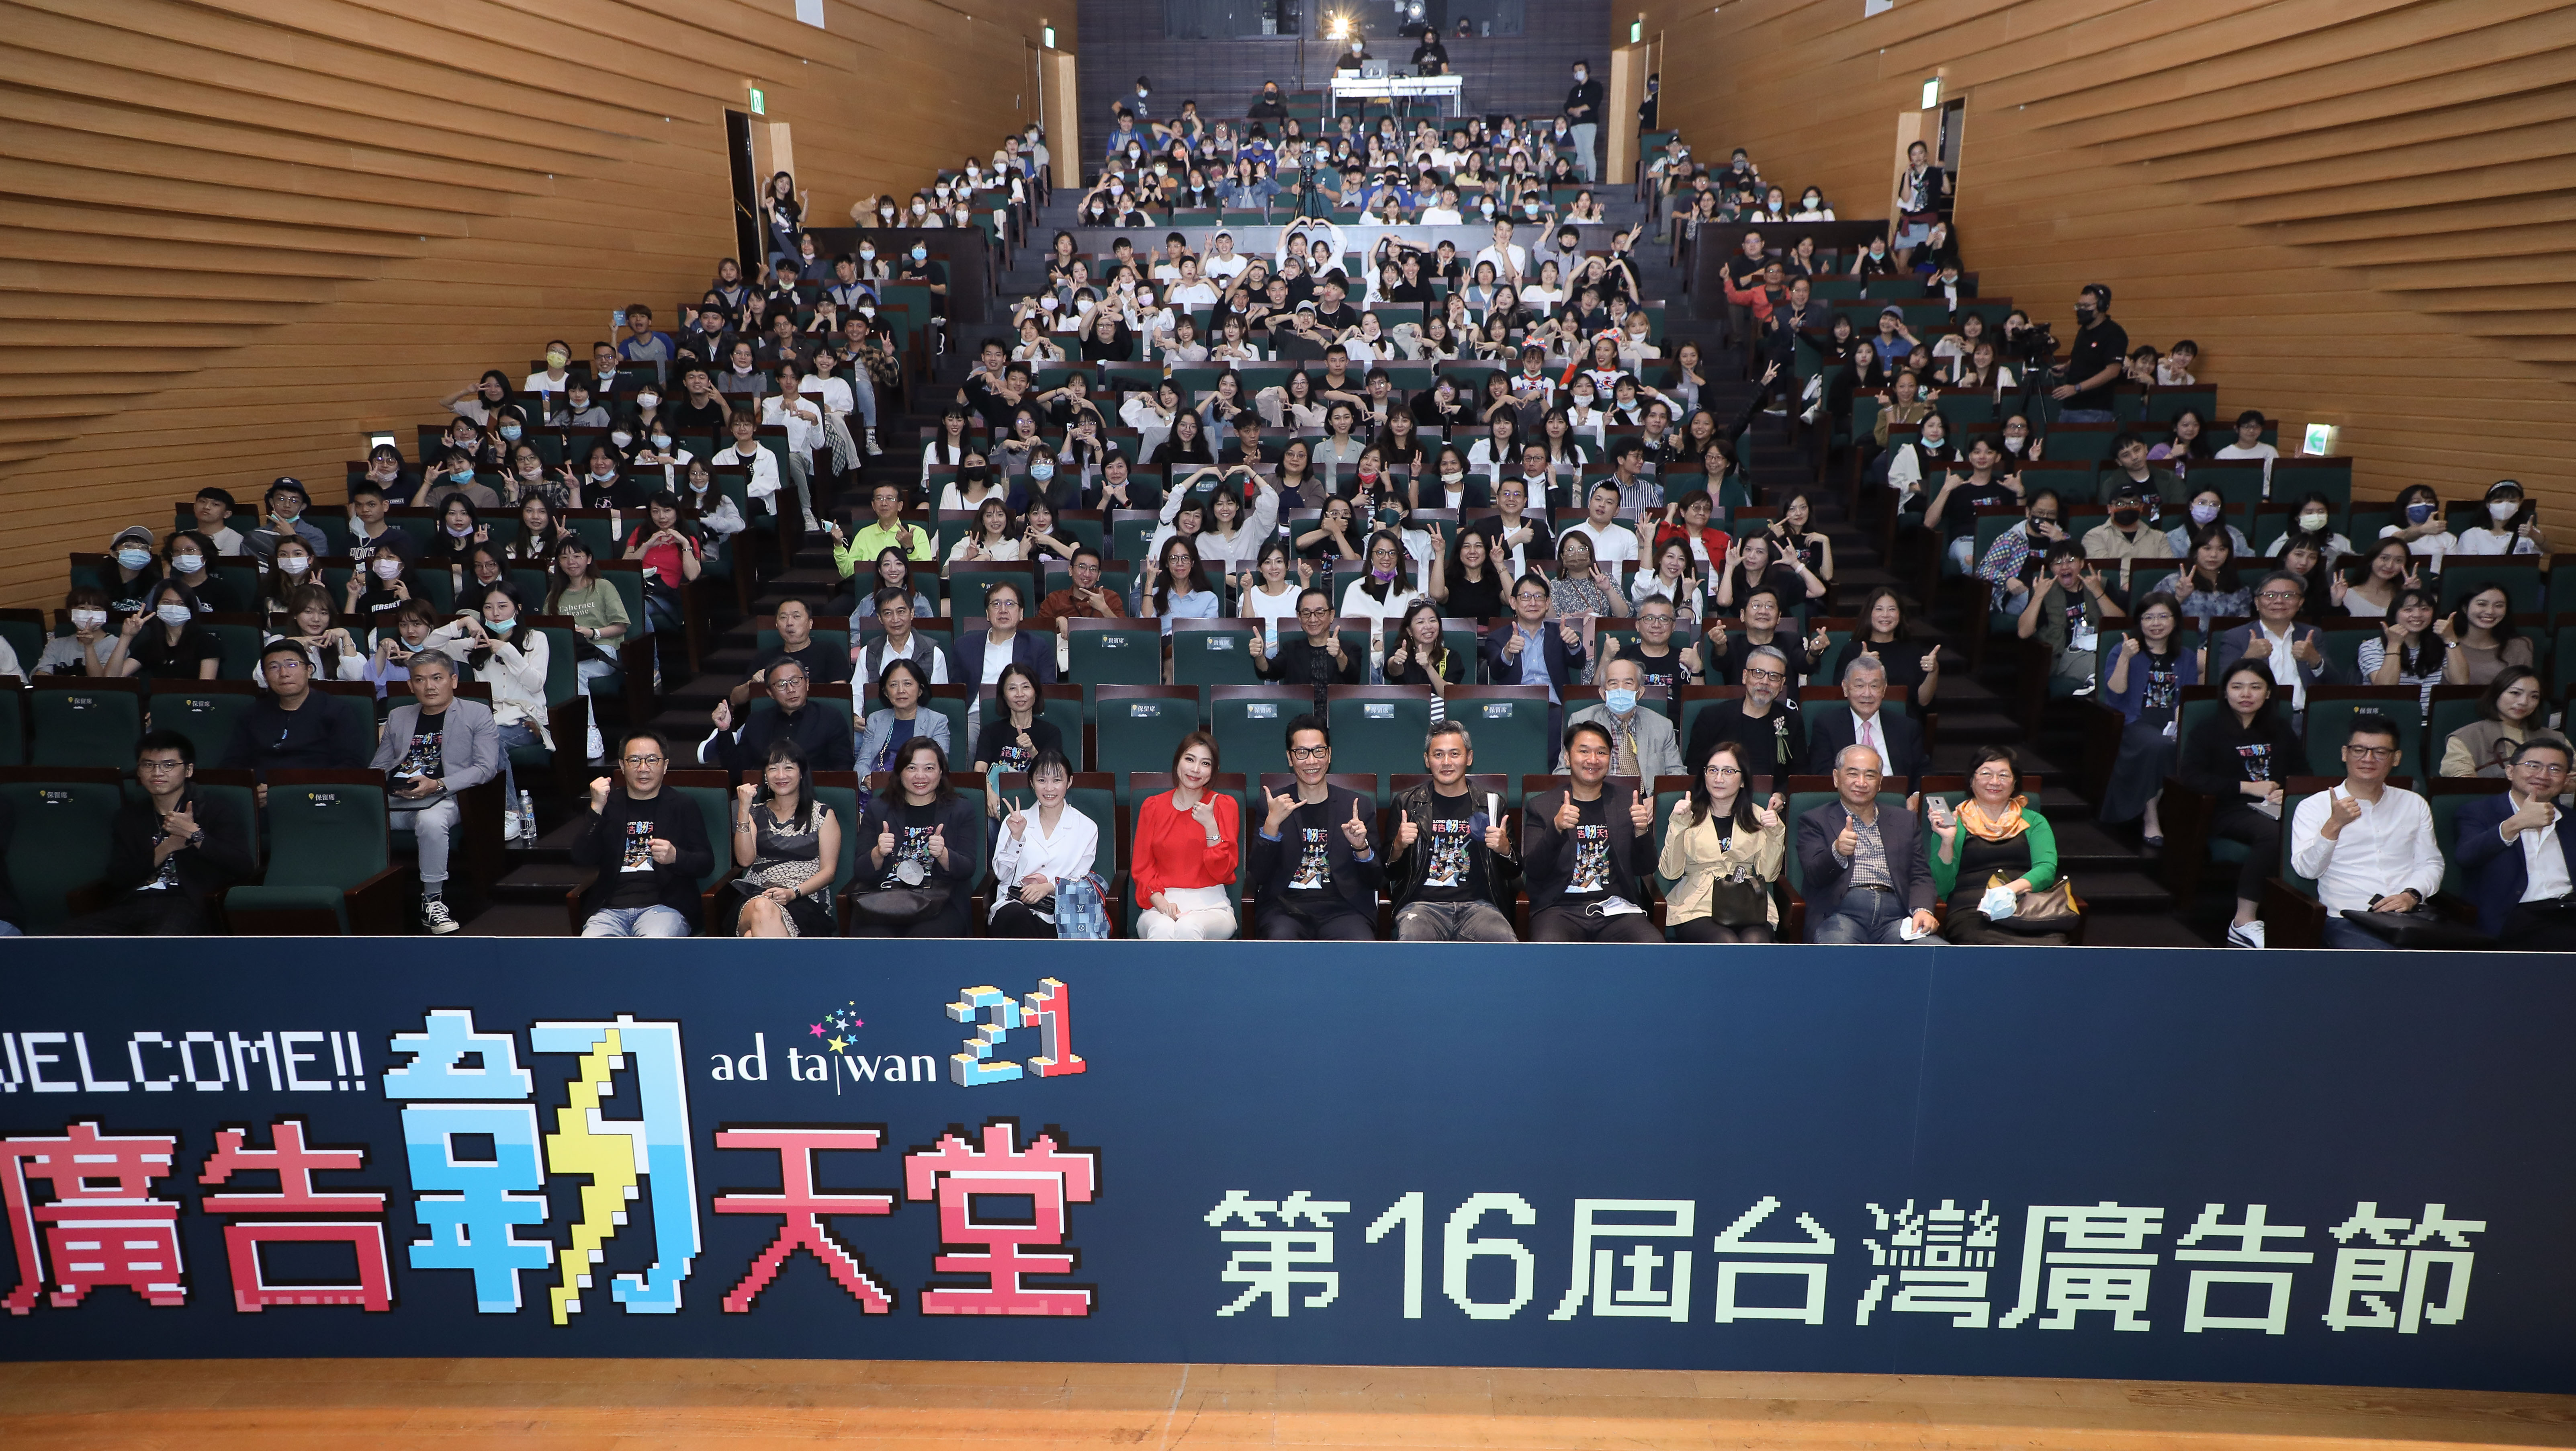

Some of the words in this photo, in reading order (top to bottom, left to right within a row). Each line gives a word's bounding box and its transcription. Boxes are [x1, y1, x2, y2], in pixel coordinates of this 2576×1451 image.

[559, 602, 595, 612] Cabernet
[711, 1033, 767, 1081] ad
[788, 1043, 936, 1096] taiwan
[945, 977, 1087, 1087] 21
[1204, 1190, 2486, 1335] 第16屆台灣廣告節
